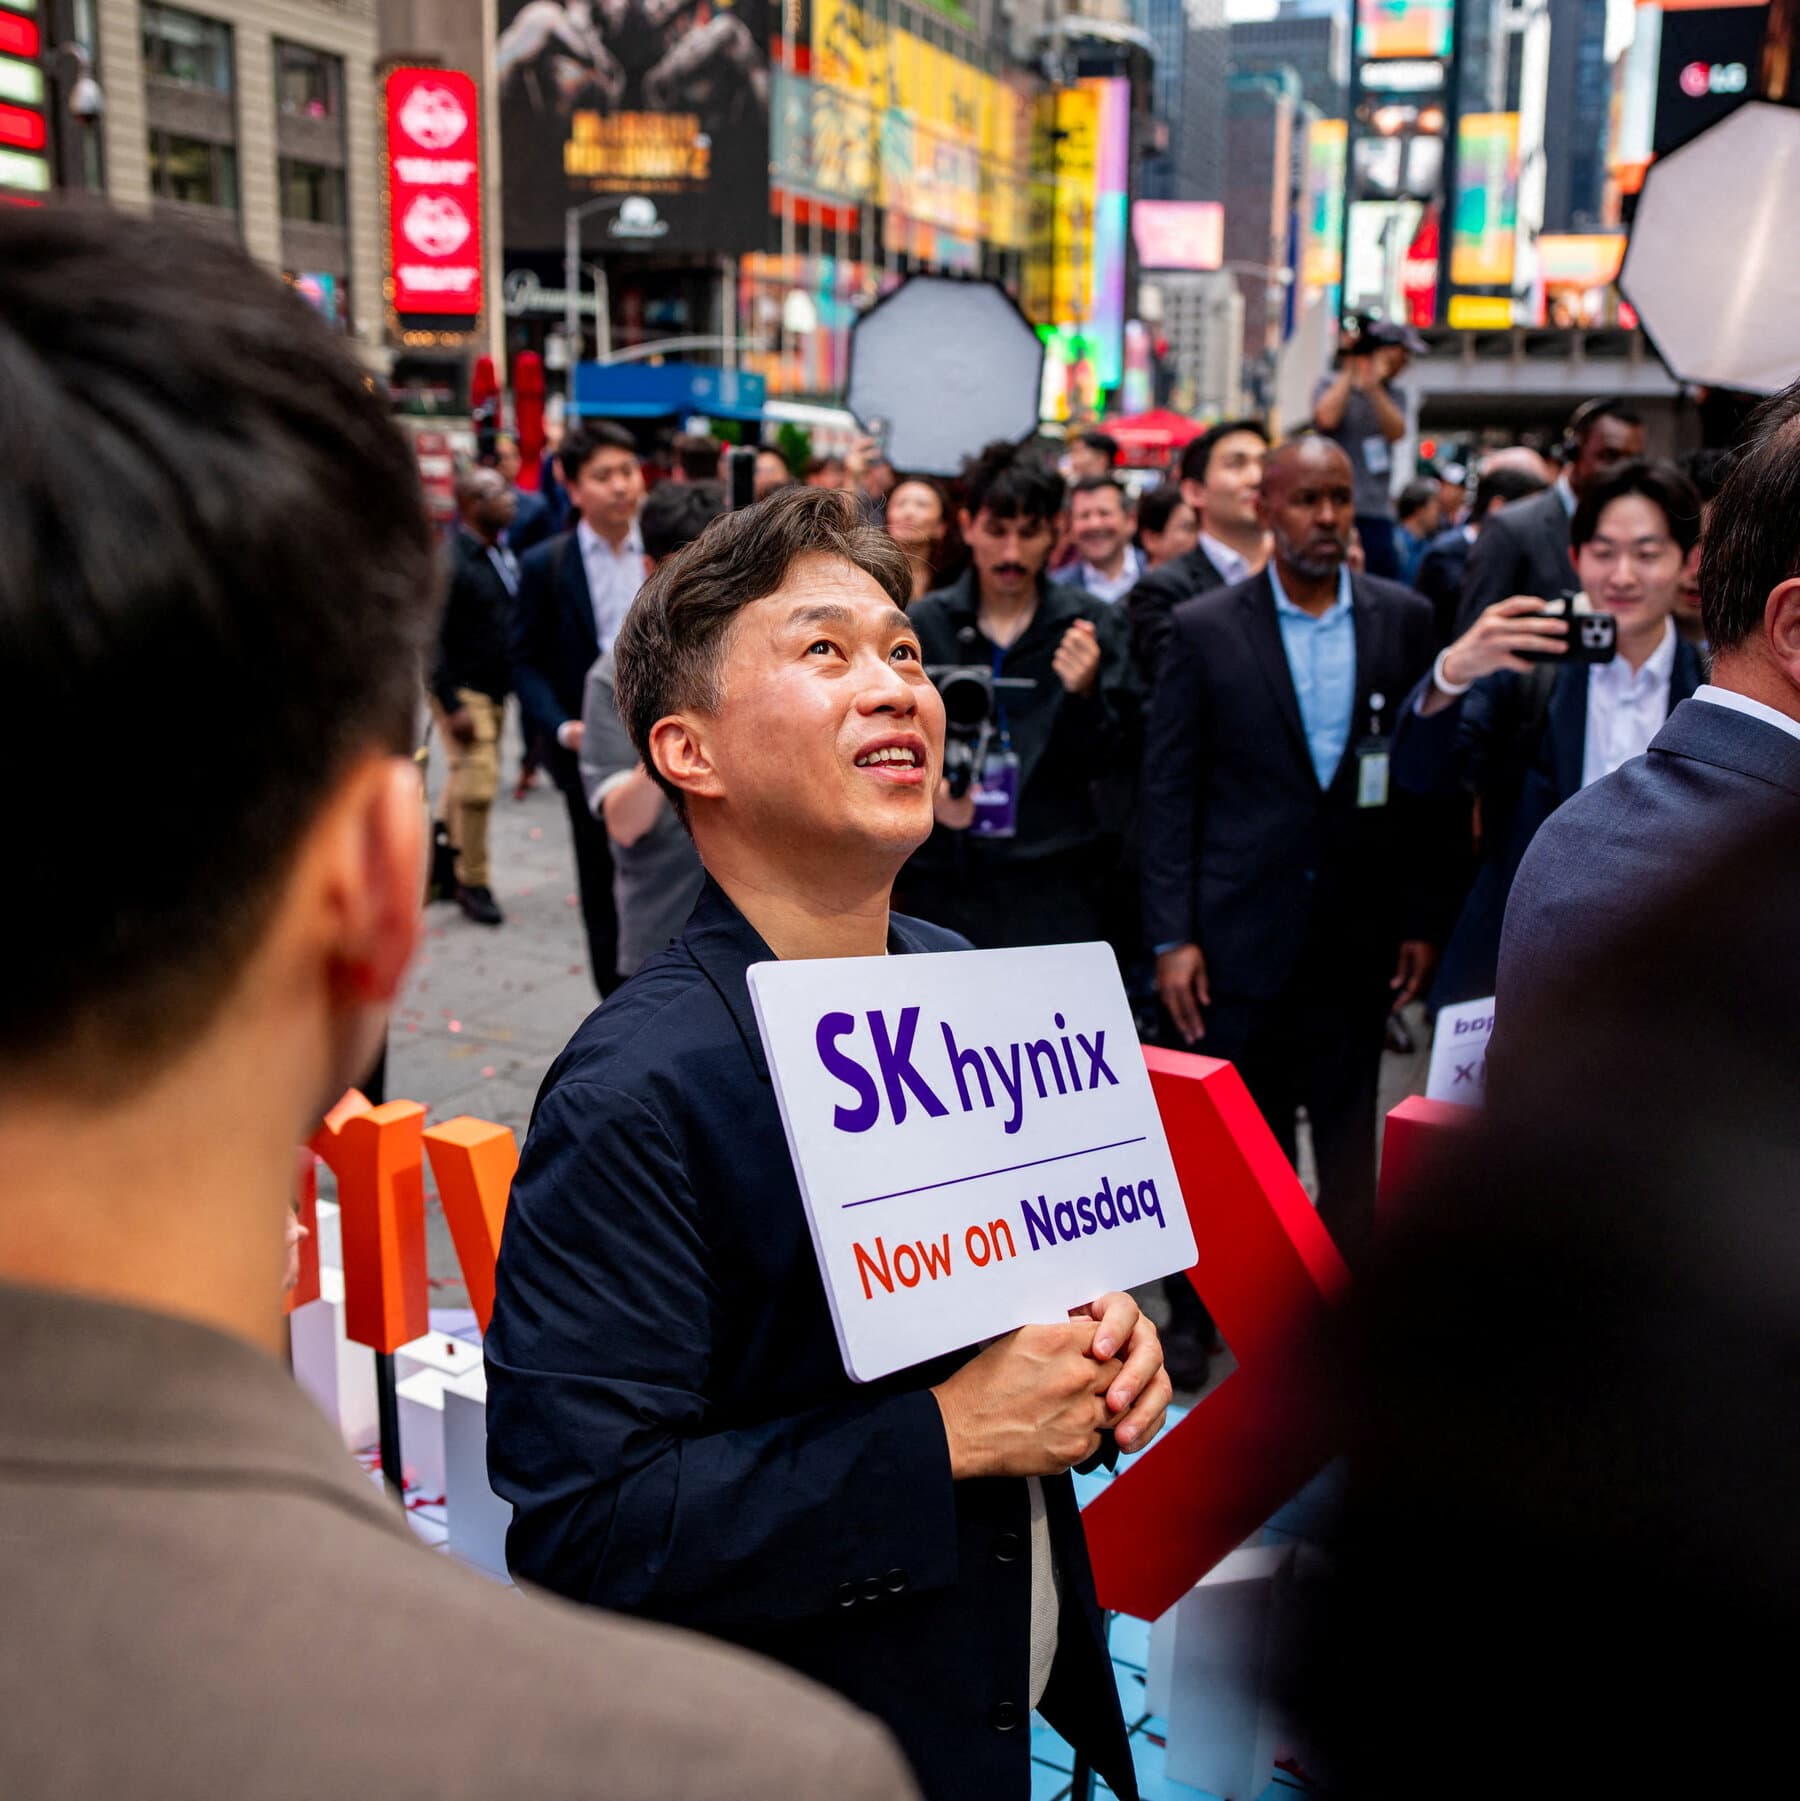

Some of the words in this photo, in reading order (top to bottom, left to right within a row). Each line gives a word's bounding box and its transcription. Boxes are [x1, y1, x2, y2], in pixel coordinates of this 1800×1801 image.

[815, 1007, 949, 1133] SK
[941, 1014, 1119, 1134] hynix
[852, 1235, 952, 1299] Now
[964, 1219, 1017, 1267] on
[1021, 1177, 1166, 1250] Nasdaq
